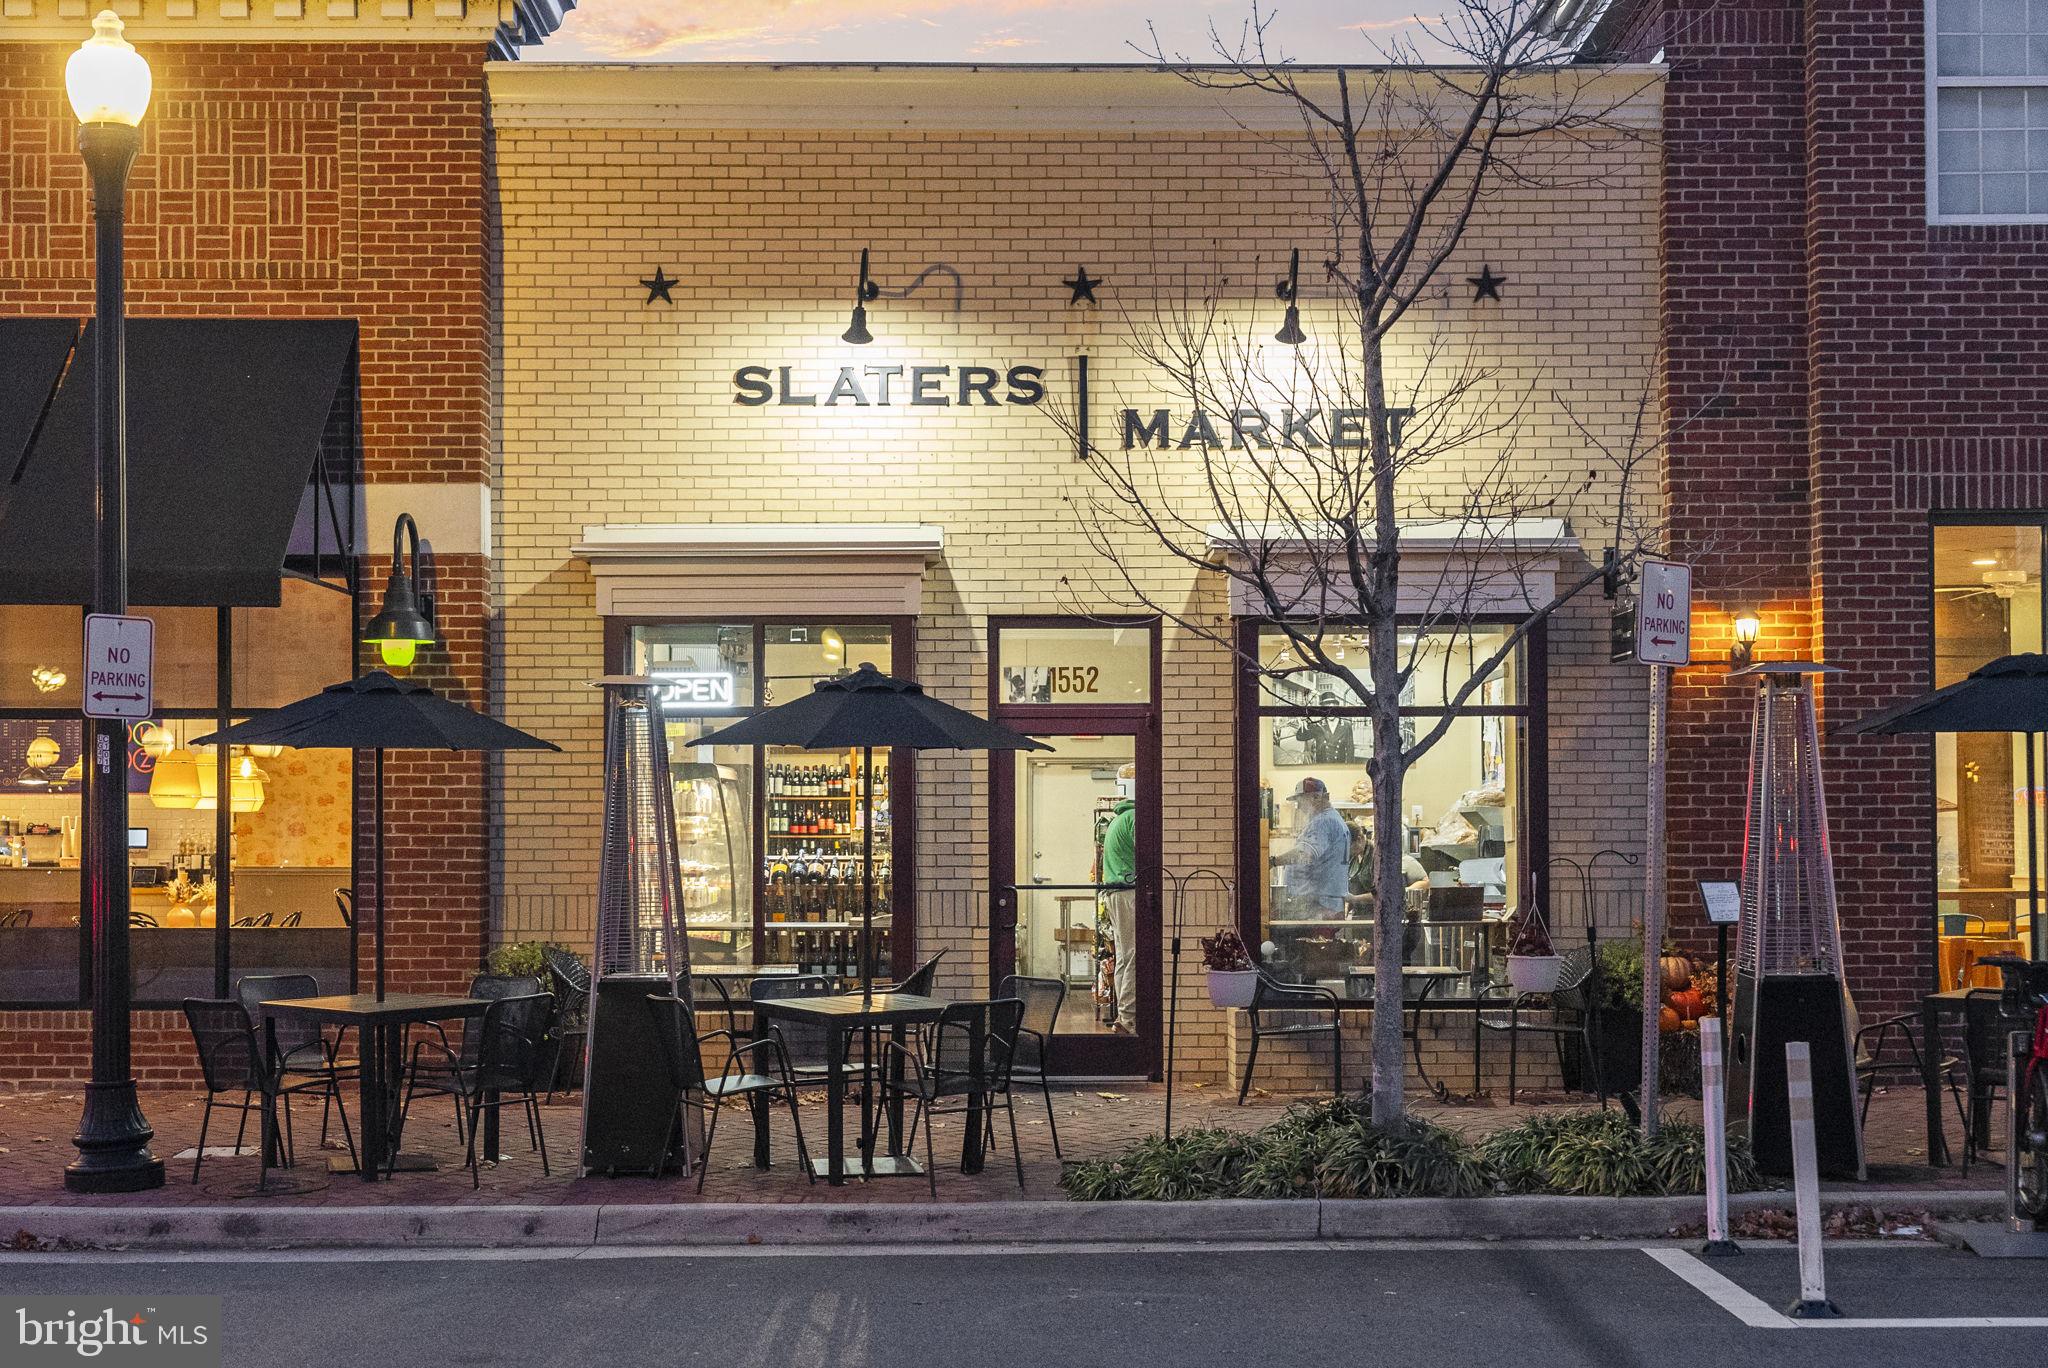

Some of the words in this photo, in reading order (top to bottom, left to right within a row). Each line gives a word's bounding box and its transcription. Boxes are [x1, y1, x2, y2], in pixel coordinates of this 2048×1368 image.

[734, 365, 1045, 407] SLATERS
[1120, 407, 1416, 450] MARKET
[1657, 593, 1674, 610] NO
[1644, 617, 1685, 635] PARKING
[108, 647, 130, 664] NO
[91, 671, 146, 688] PARKING
[1050, 666, 1099, 693] 1552
